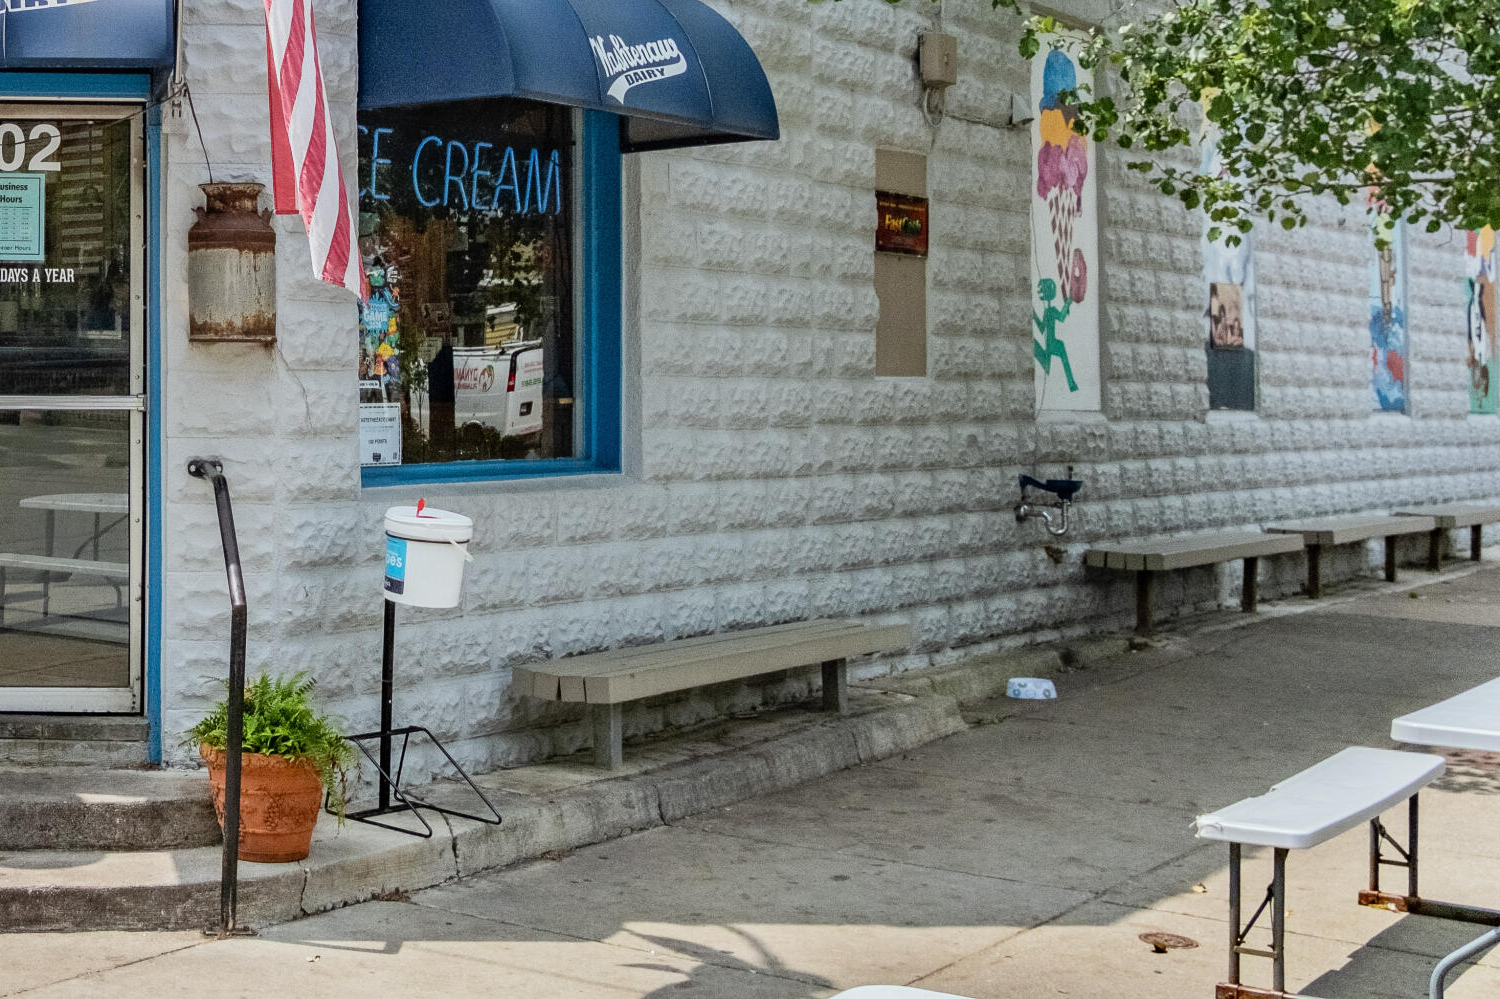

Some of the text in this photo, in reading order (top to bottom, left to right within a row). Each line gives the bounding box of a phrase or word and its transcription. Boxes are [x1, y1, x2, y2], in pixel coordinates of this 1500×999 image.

[624, 67, 666, 87] DAIRY
[412, 135, 561, 216] CREAM
[0, 195, 22, 203] Hours
[0, 267, 29, 283] DAYS
[32, 267, 41, 283] A
[44, 267, 75, 283] YEAR
